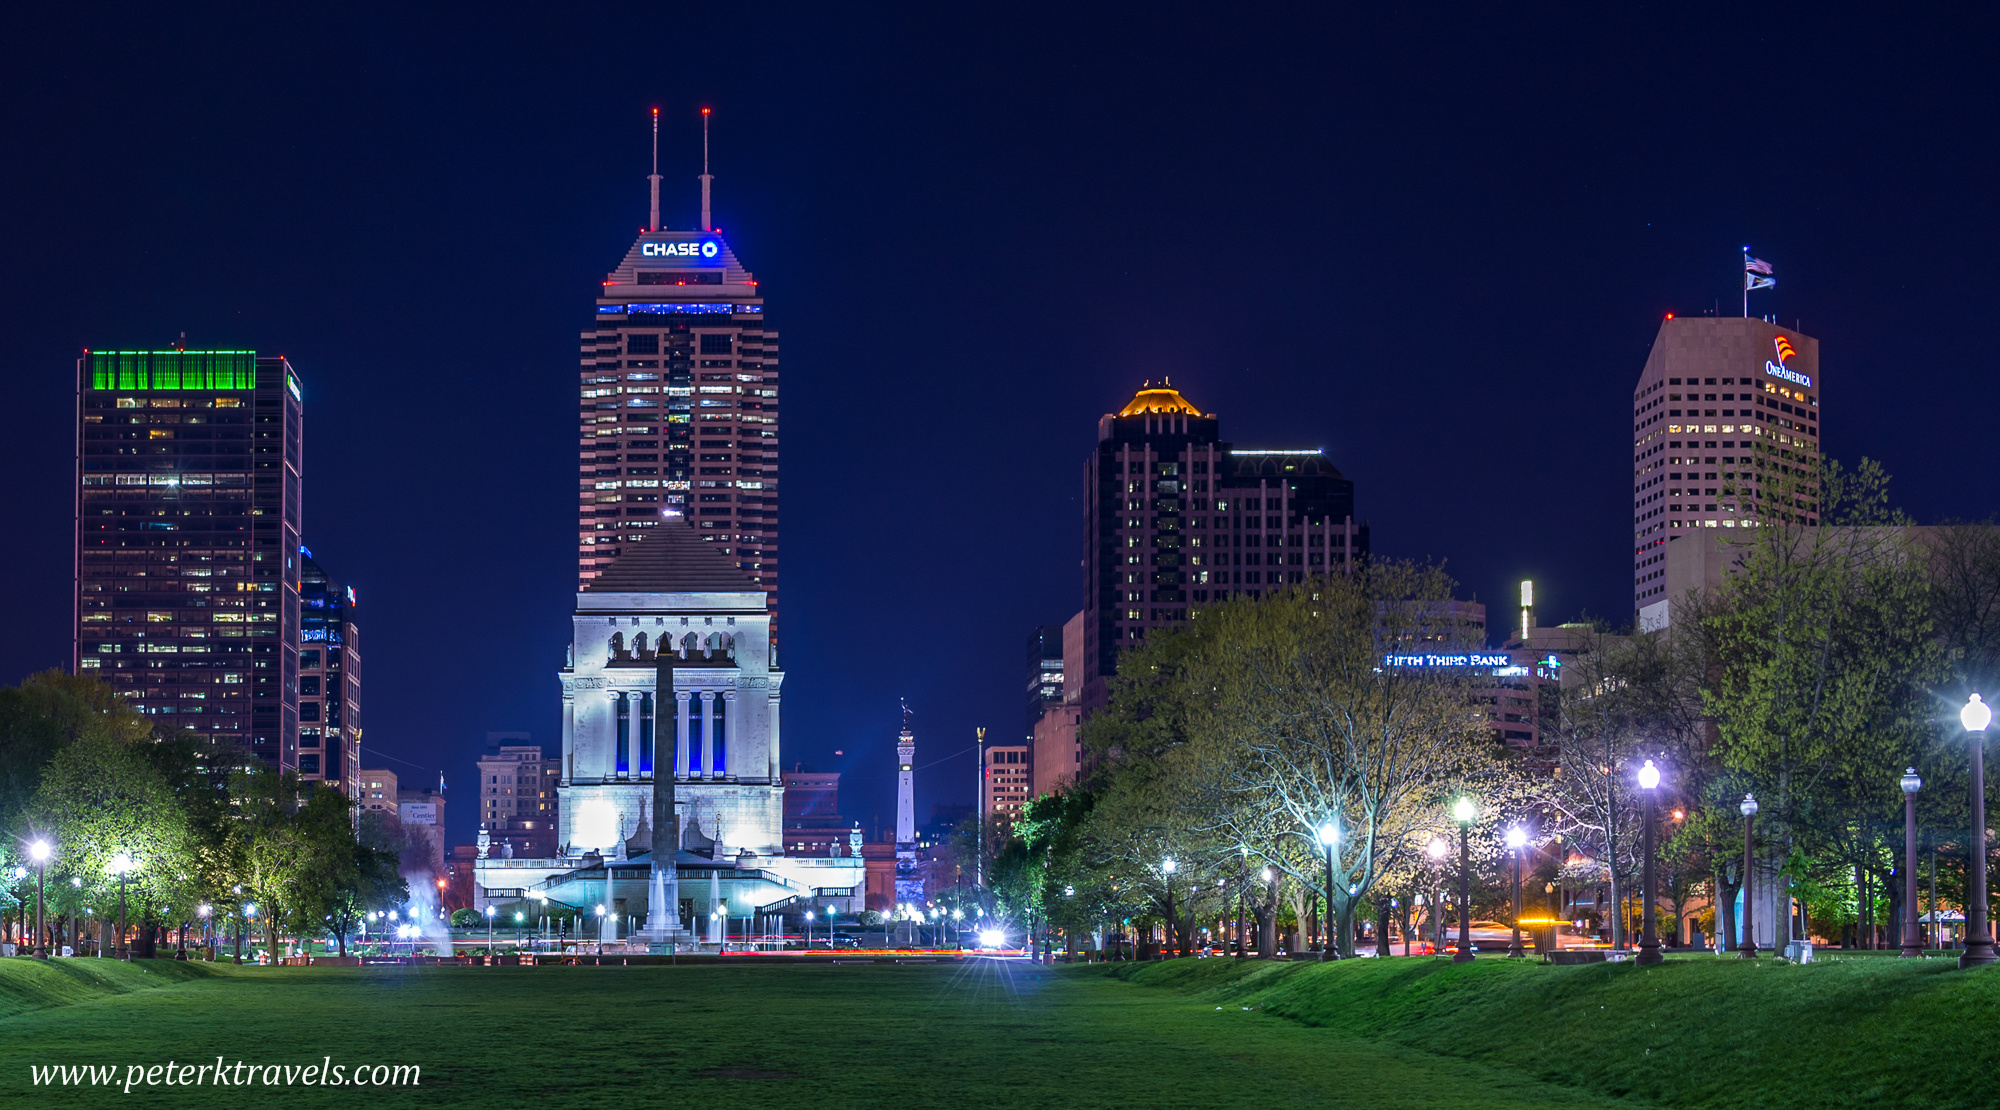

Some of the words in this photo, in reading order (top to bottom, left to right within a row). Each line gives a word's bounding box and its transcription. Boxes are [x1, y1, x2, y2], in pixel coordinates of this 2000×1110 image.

[642, 243, 700, 256] CHASE
[1386, 655, 1423, 666] FIFTH
[1426, 654, 1468, 666] THIRD
[1470, 654, 1508, 666] BANK
